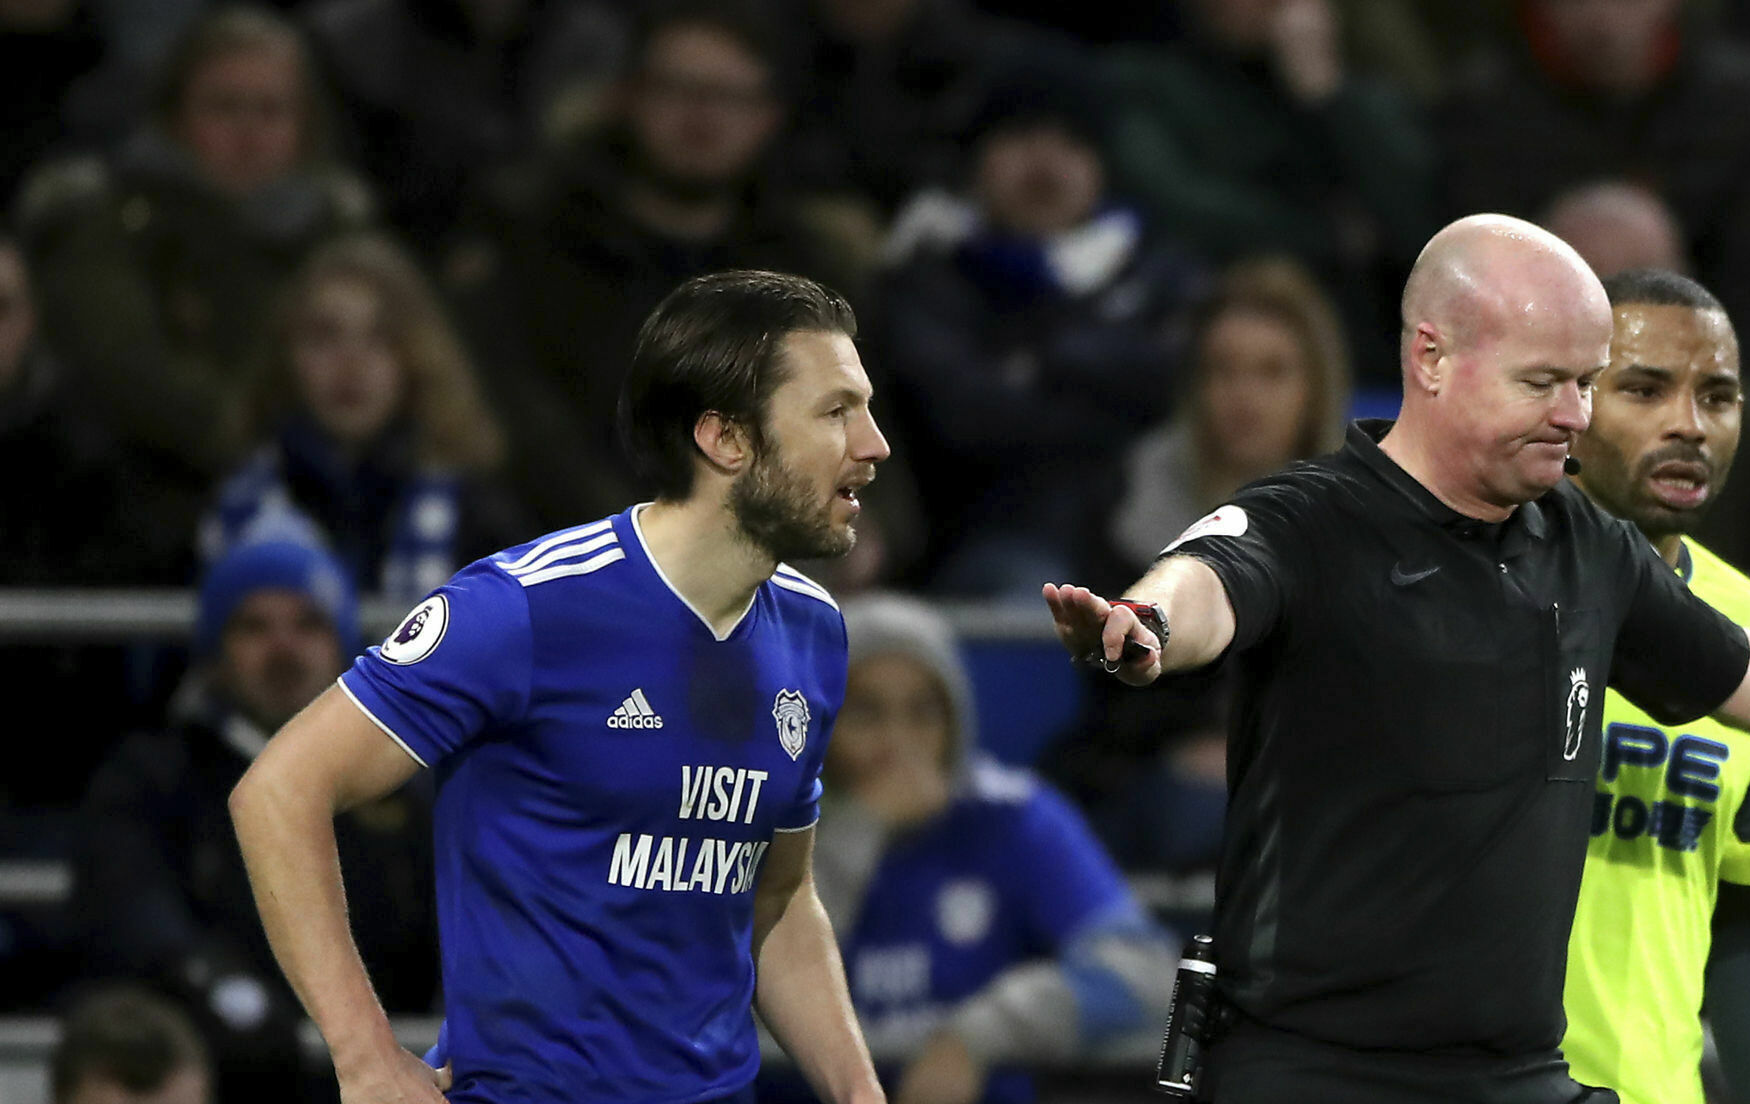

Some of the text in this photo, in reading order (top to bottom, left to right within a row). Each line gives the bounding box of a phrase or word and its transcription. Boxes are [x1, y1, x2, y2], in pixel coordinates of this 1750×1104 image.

[606, 714, 663, 729] adidas
[1602, 721, 1730, 803] PE
[678, 765, 768, 824] VISIT
